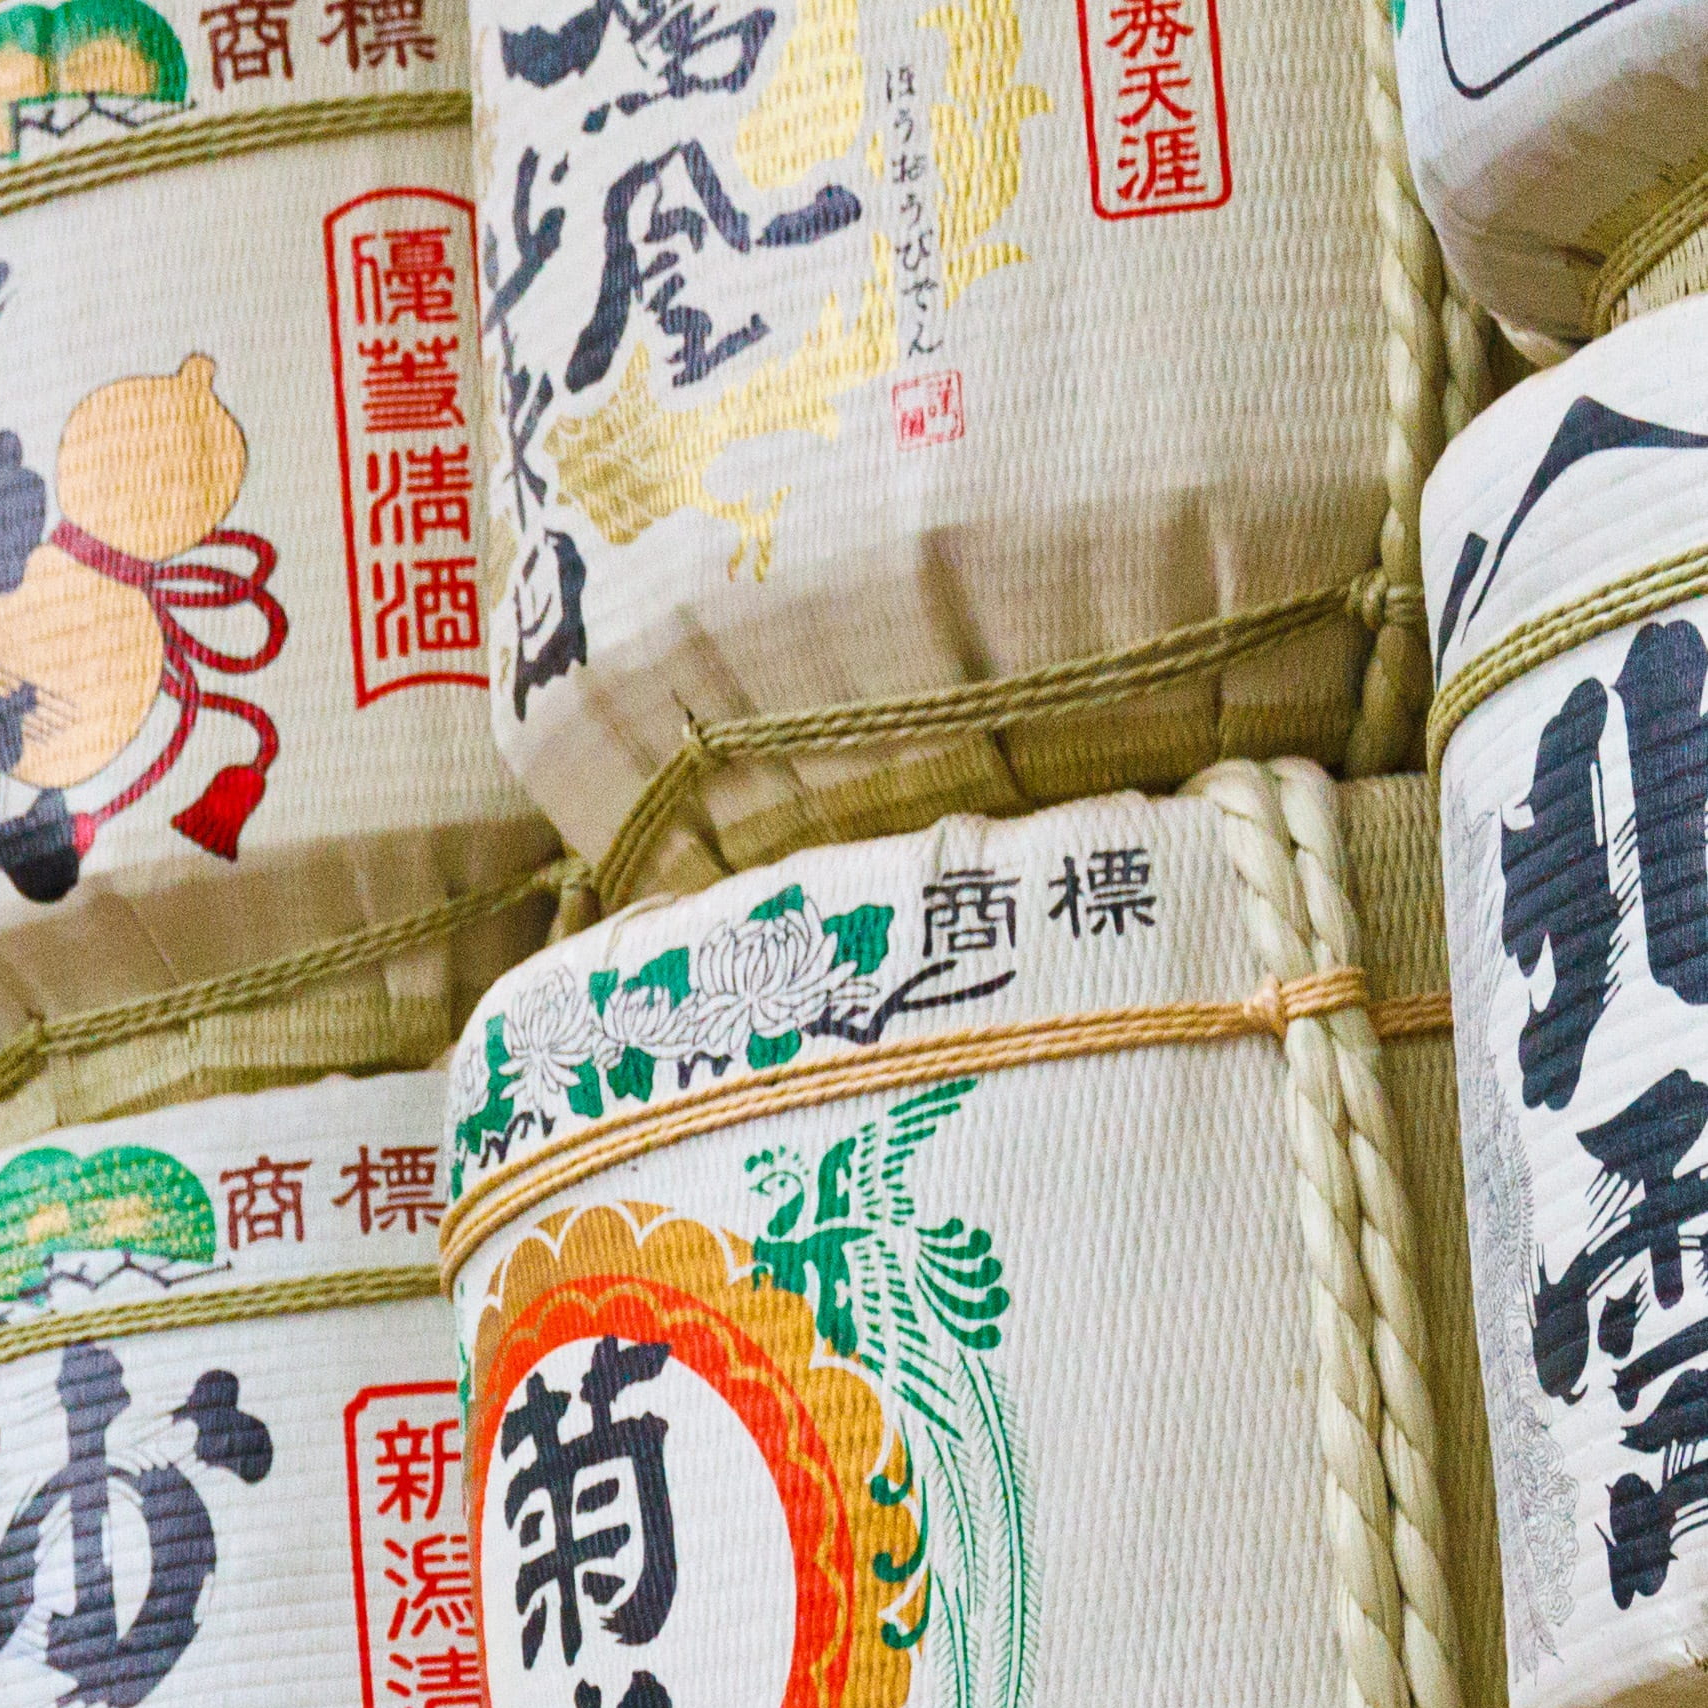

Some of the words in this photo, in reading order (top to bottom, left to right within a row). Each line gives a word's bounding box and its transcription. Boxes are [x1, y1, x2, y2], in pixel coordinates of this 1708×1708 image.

[203, 0, 439, 92] 商標
[921, 847, 1157, 959] 商標
[221, 1145, 447, 1251] 商標
